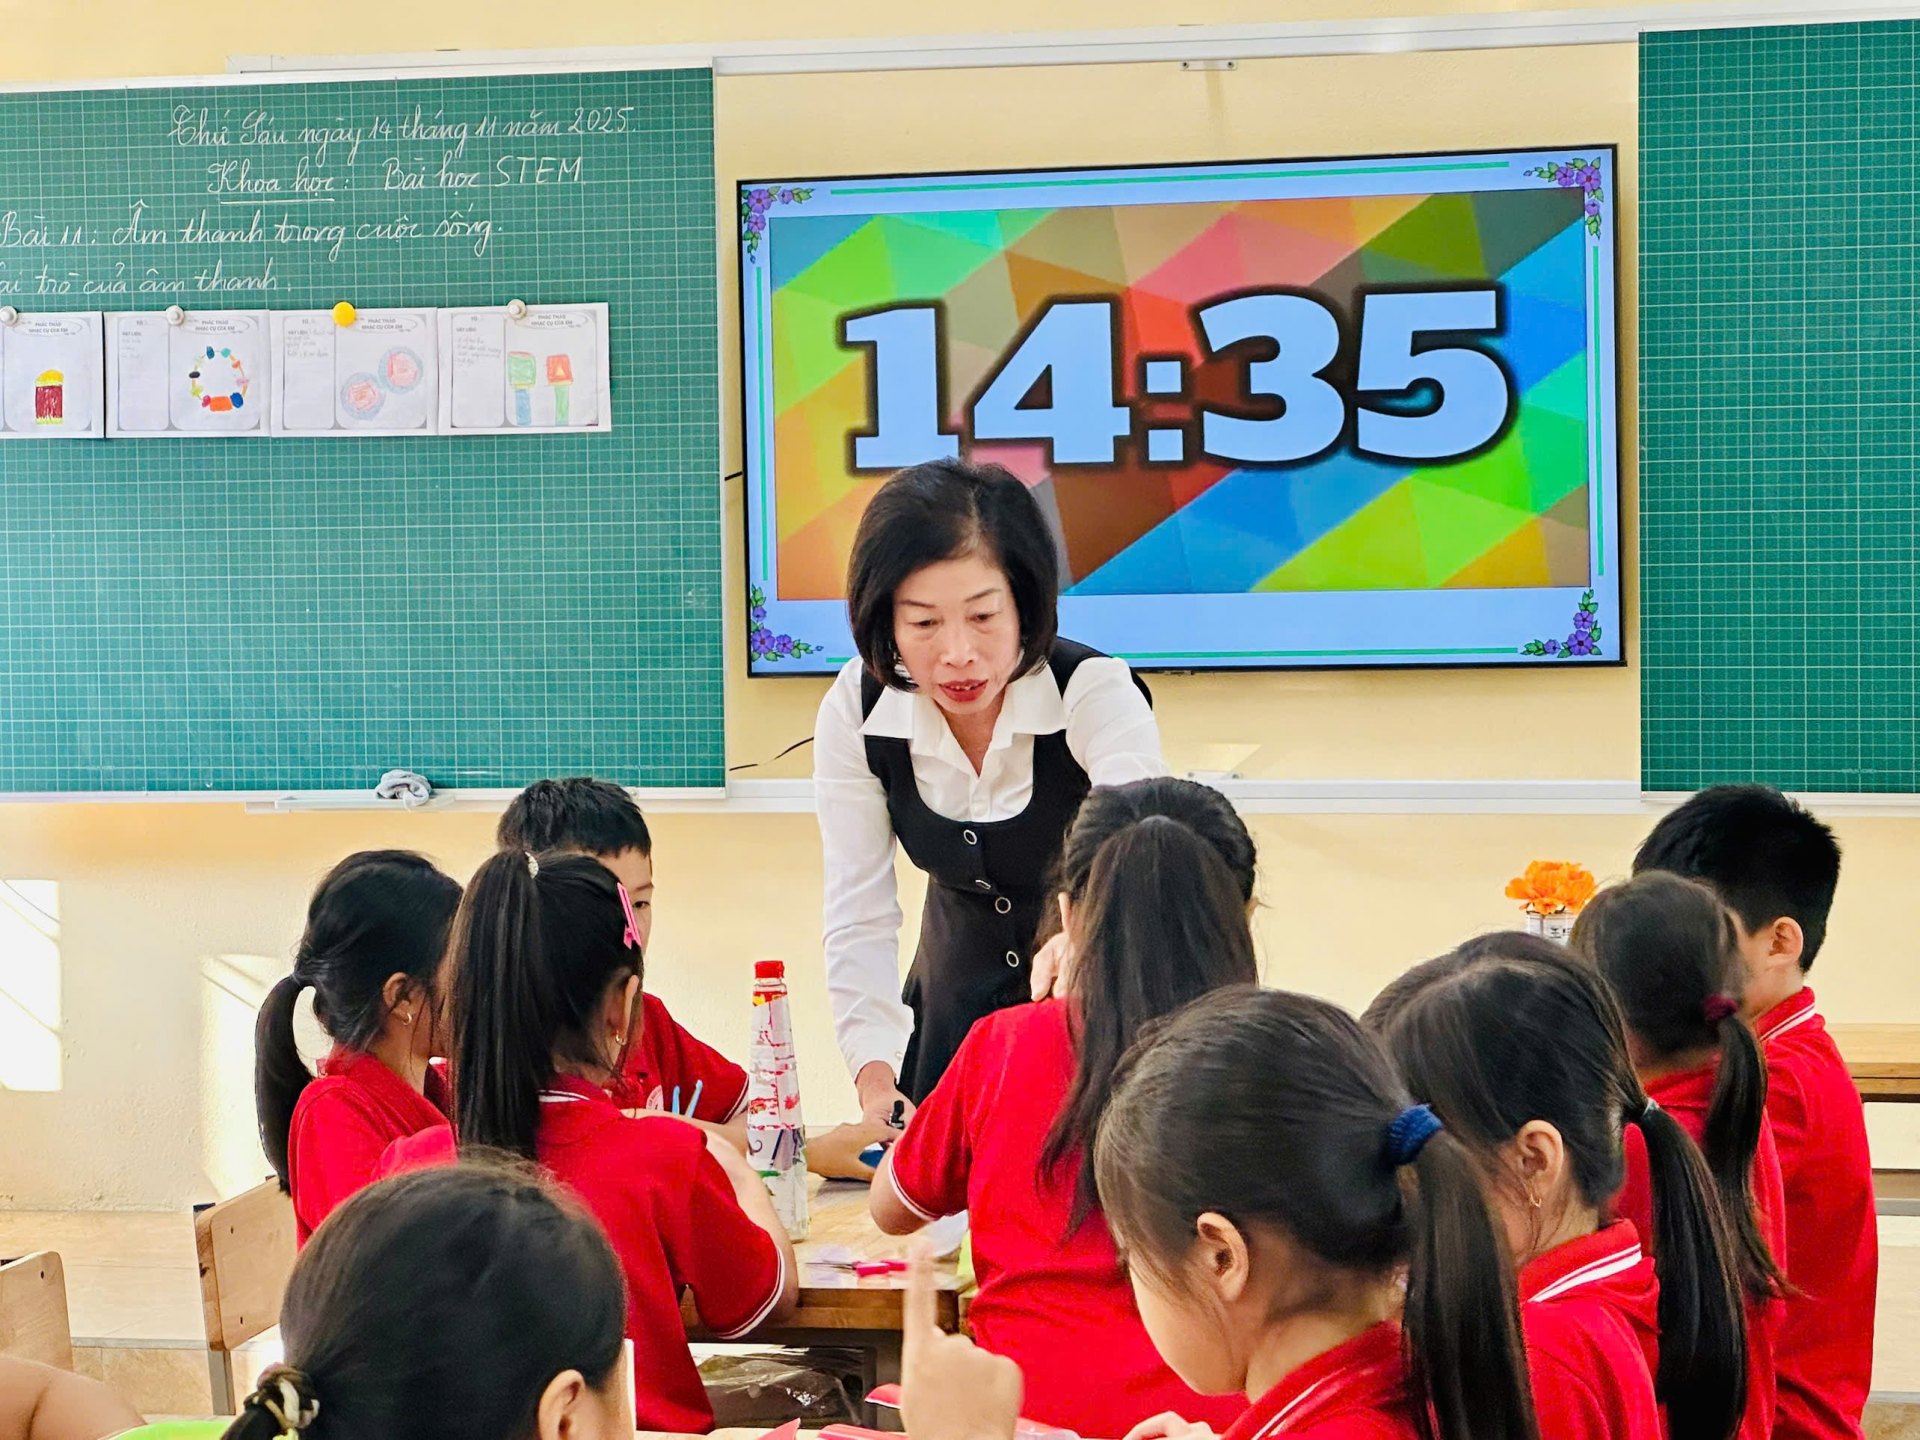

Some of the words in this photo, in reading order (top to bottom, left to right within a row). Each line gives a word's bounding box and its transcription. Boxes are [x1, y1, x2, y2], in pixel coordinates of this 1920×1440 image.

[168, 104, 230, 146] Thứ
[240, 109, 289, 145] Sáu
[298, 117, 361, 168] ngày
[368, 116, 393, 141] 14
[398, 103, 468, 159] tháng
[474, 115, 497, 138] 11
[502, 108, 562, 137] năm
[207, 158, 281, 193] Khoa
[382, 156, 425, 191] Bài
[434, 150, 481, 196] học
[0, 210, 51, 247] Bài
[112, 198, 168, 245] Âm
[179, 208, 264, 244] thanh
[274, 212, 346, 263] trong
[356, 214, 422, 243] cuộc
[0, 262, 22, 294] ai
[35, 263, 81, 294] trò
[82, 262, 128, 294] của
[138, 268, 185, 292] âm
[842, 287, 1513, 472] 14:35
